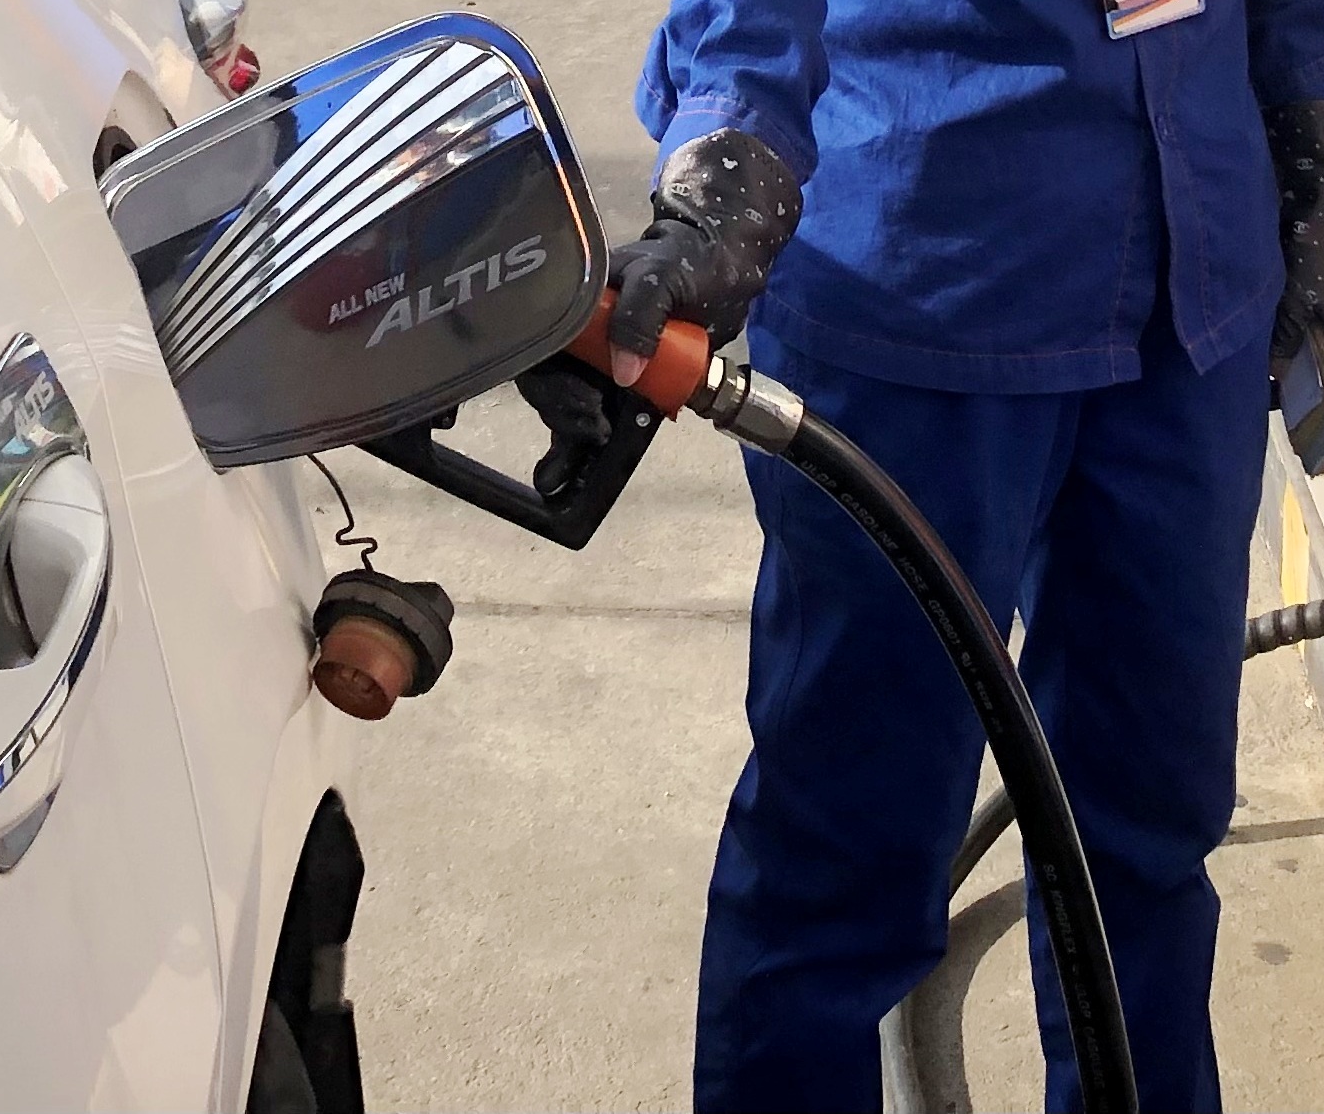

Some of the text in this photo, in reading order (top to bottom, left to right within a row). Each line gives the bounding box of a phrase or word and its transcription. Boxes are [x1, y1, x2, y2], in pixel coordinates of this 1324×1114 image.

[328, 272, 406, 326] ALL NEW
[364, 234, 548, 349] ALTIS
